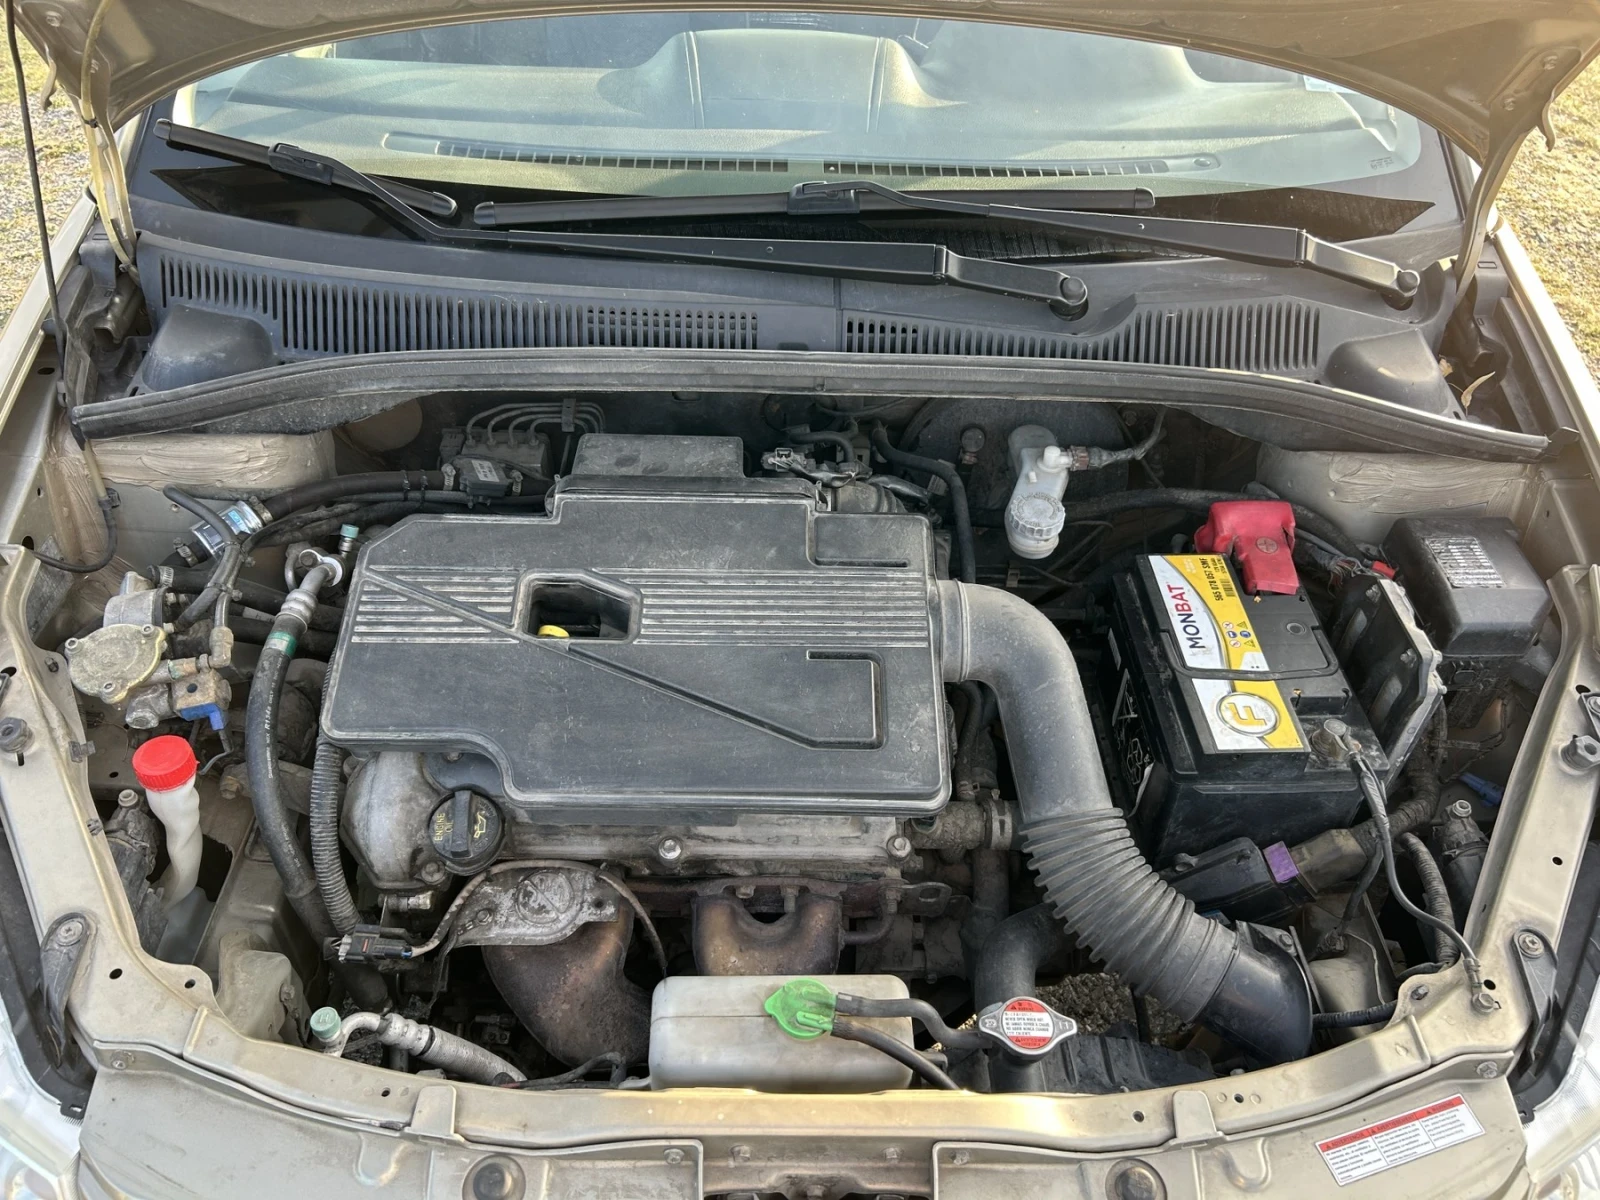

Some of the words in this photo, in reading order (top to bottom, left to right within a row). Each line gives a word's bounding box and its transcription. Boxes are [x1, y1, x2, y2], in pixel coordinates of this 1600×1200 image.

[1199, 558, 1211, 569] SMF
[1167, 584, 1206, 649] MONBAT
[264, 705, 272, 730] R134a
[434, 812, 446, 841] ENGINE
